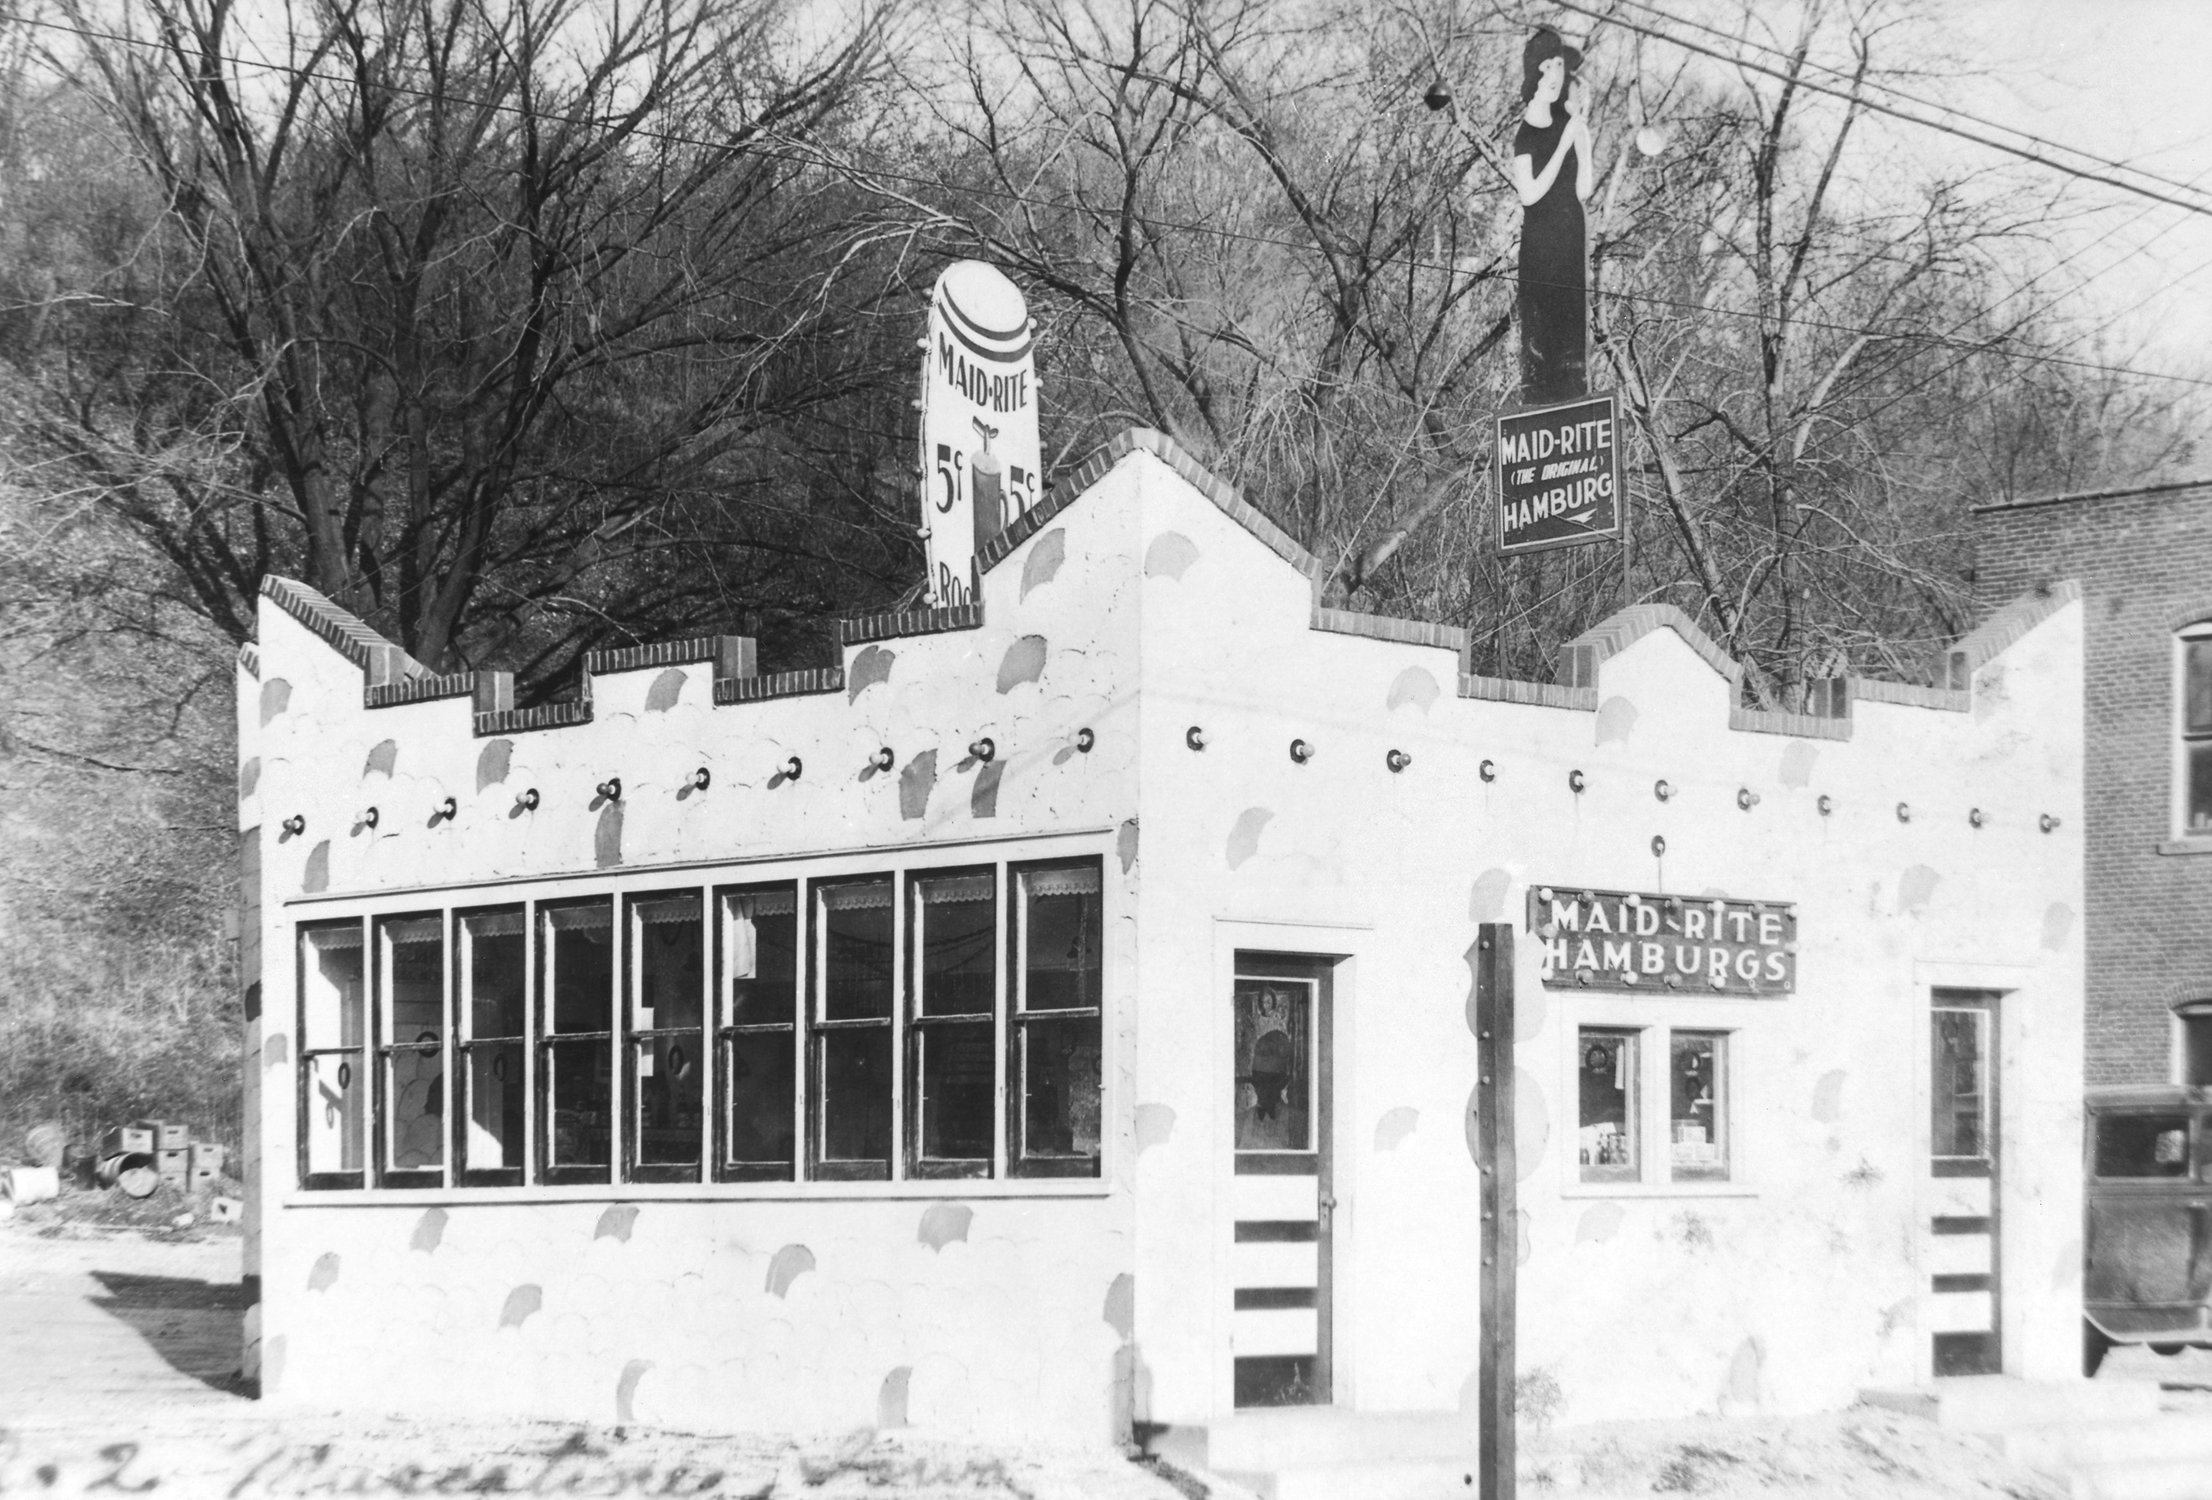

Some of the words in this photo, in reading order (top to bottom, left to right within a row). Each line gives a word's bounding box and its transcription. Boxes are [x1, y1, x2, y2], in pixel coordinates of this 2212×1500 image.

[1502, 418, 1611, 466] MAID-RITE
[1504, 473, 1613, 533] HAMBURG
[1552, 899, 1783, 945] MAID-RITE
[1546, 939, 1786, 980] HAMBURGS
